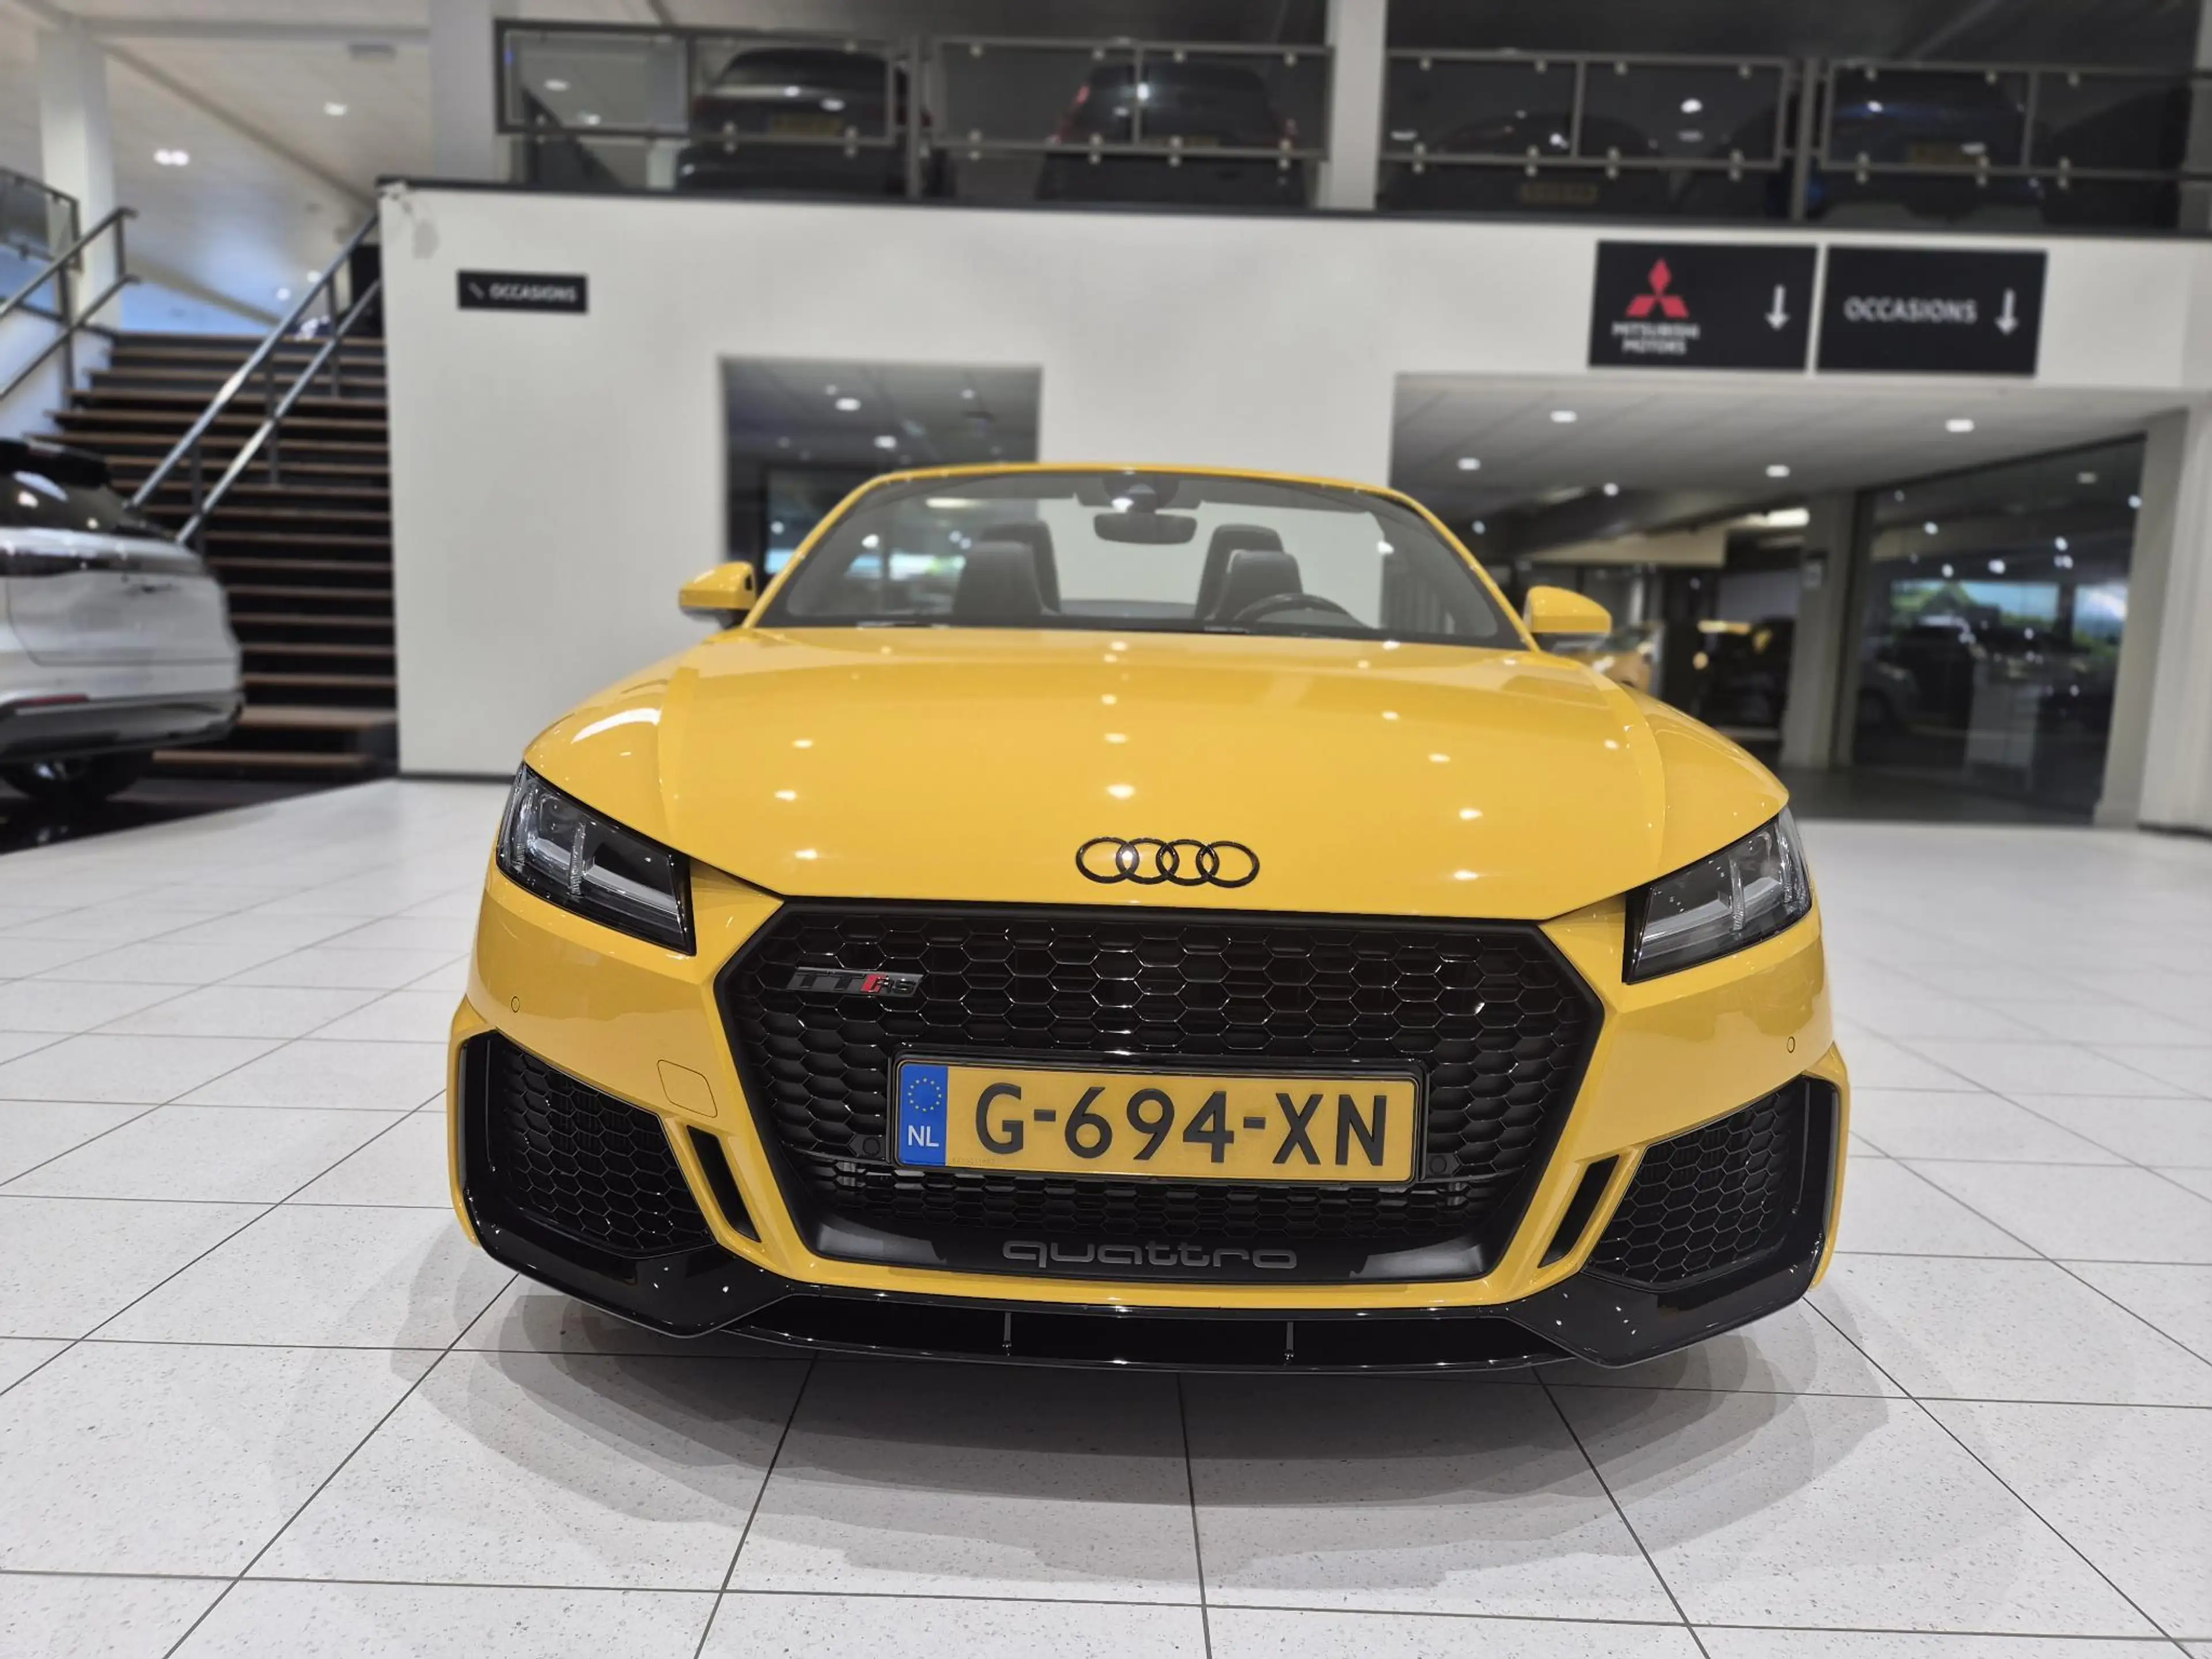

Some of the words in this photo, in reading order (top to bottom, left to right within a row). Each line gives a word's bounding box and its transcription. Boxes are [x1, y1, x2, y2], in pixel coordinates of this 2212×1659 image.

[1845, 297, 1977, 324] OCCASIONS
[908, 1125, 940, 1147] NL
[975, 1082, 1387, 1166] G-694-XN
[1003, 1240, 1297, 1269] quattro
